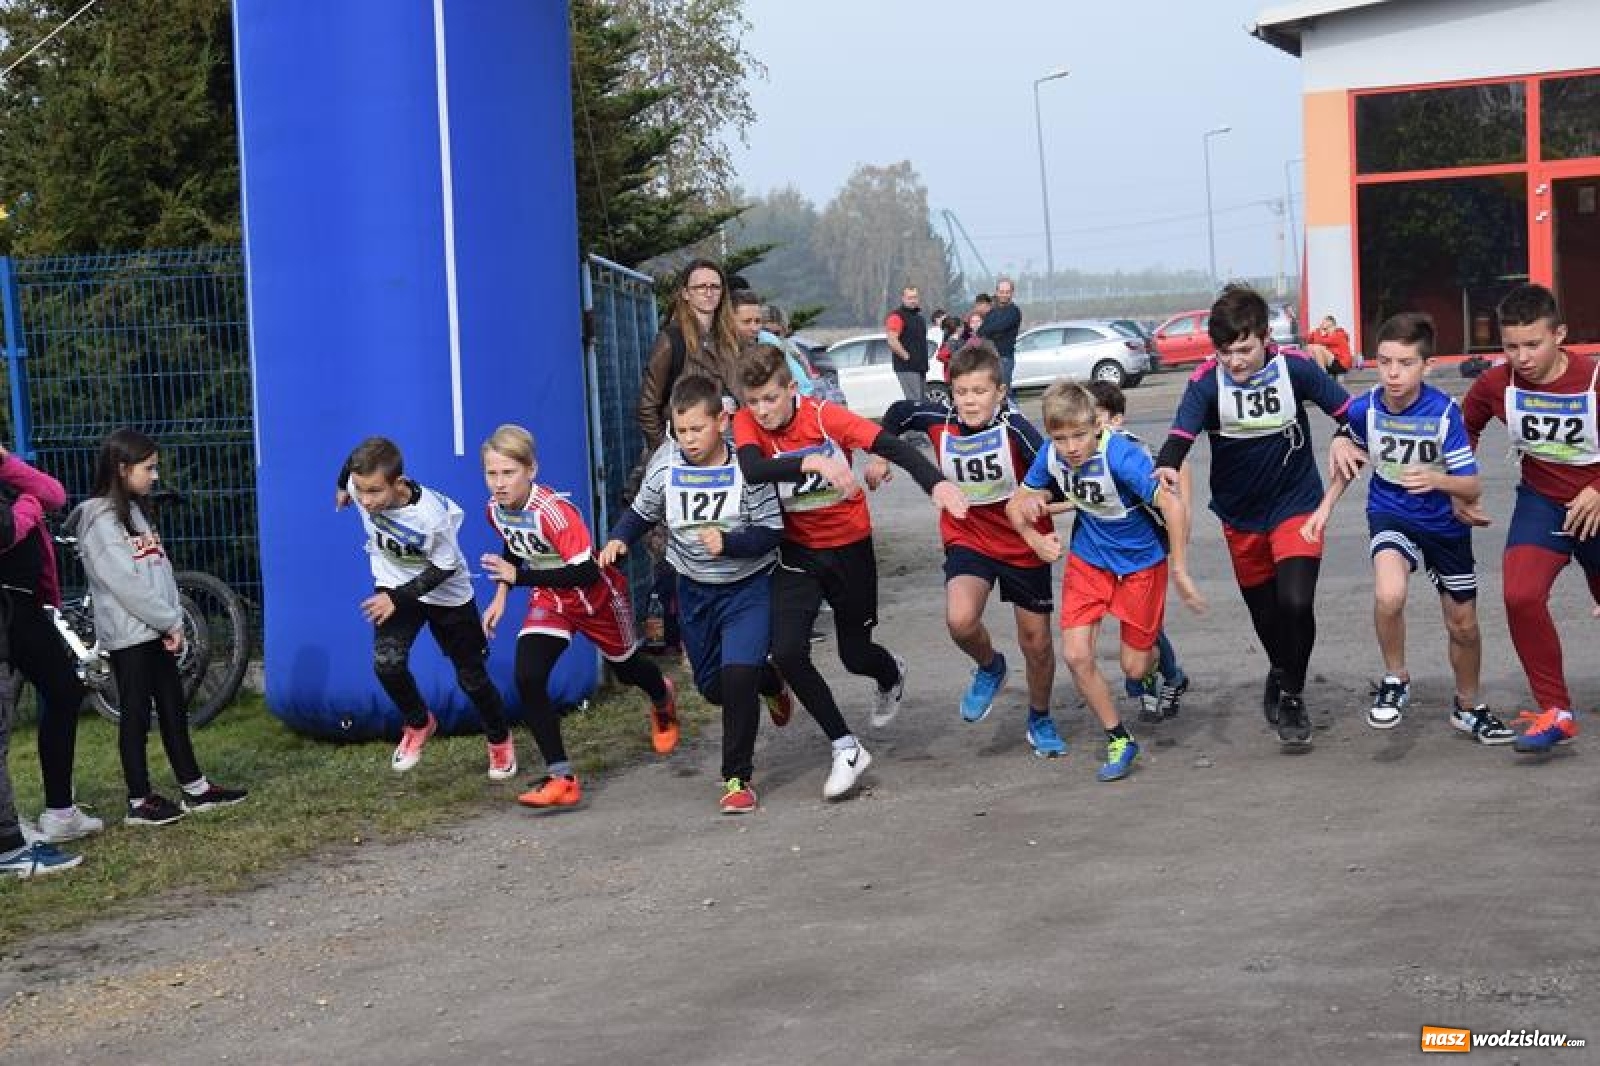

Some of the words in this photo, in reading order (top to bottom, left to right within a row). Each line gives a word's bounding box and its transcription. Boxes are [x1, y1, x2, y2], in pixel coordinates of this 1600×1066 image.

[1232, 387, 1281, 419] 136
[1521, 414, 1585, 444] 672
[1380, 435, 1439, 465] 270
[951, 453, 1003, 483] 195
[679, 491, 728, 521] 127
